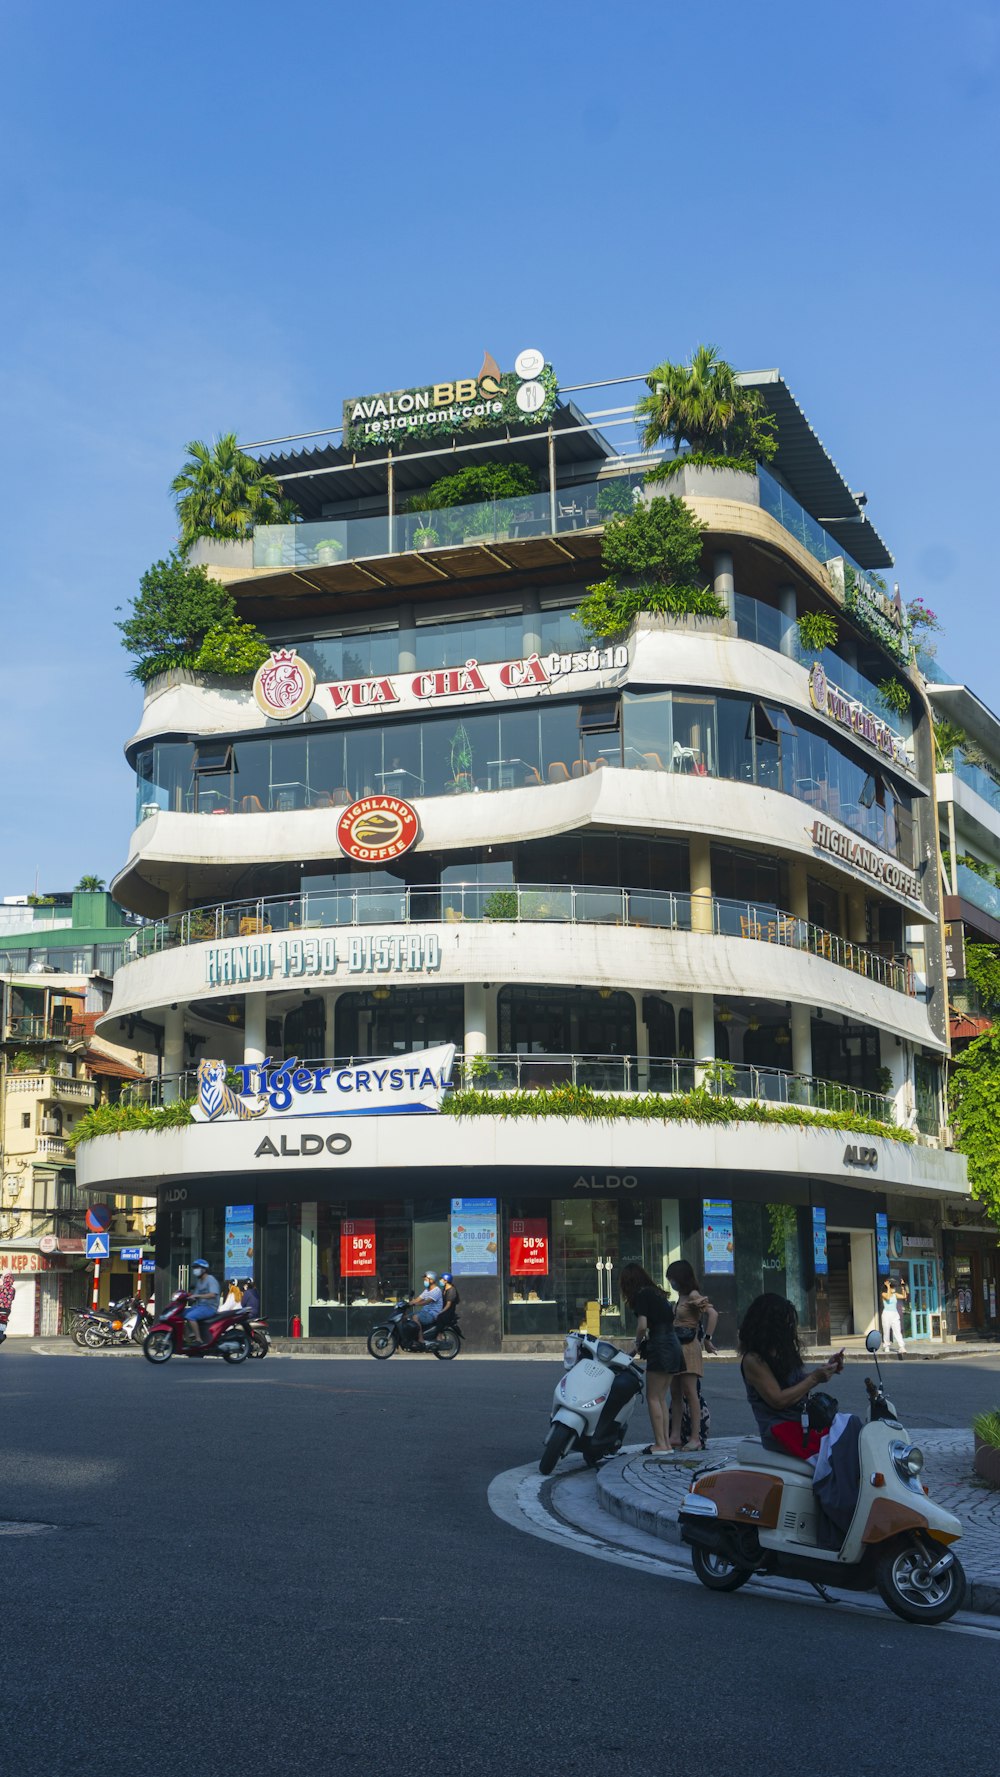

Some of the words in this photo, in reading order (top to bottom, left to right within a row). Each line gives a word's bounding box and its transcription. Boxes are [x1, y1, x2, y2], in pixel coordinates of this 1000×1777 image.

[351, 392, 429, 421] AVALON
[433, 374, 508, 407] BBQ
[327, 678, 399, 709] VUA
[411, 659, 488, 699] CHẢ
[500, 653, 551, 688] CÁ
[604, 646, 628, 667] 10
[341, 800, 413, 829] HIGHLANDS
[350, 840, 406, 859] COFFEE
[813, 821, 884, 877] HIGHLANDS
[883, 863, 921, 900] COFFEE
[205, 942, 271, 983] HANOI
[279, 937, 337, 975] 1930
[347, 934, 439, 972] BISTRO
[234, 1055, 331, 1110] Tiger
[336, 1067, 454, 1092] CRYSTAL
[254, 1132, 352, 1157] ALDO
[843, 1144, 878, 1168] ALDO
[573, 1175, 638, 1189] ALDO
[165, 1188, 188, 1203] ALDO
[353, 1239, 372, 1249] 50%
[523, 1237, 544, 1248] 50%
[762, 1259, 781, 1269] ALDO
